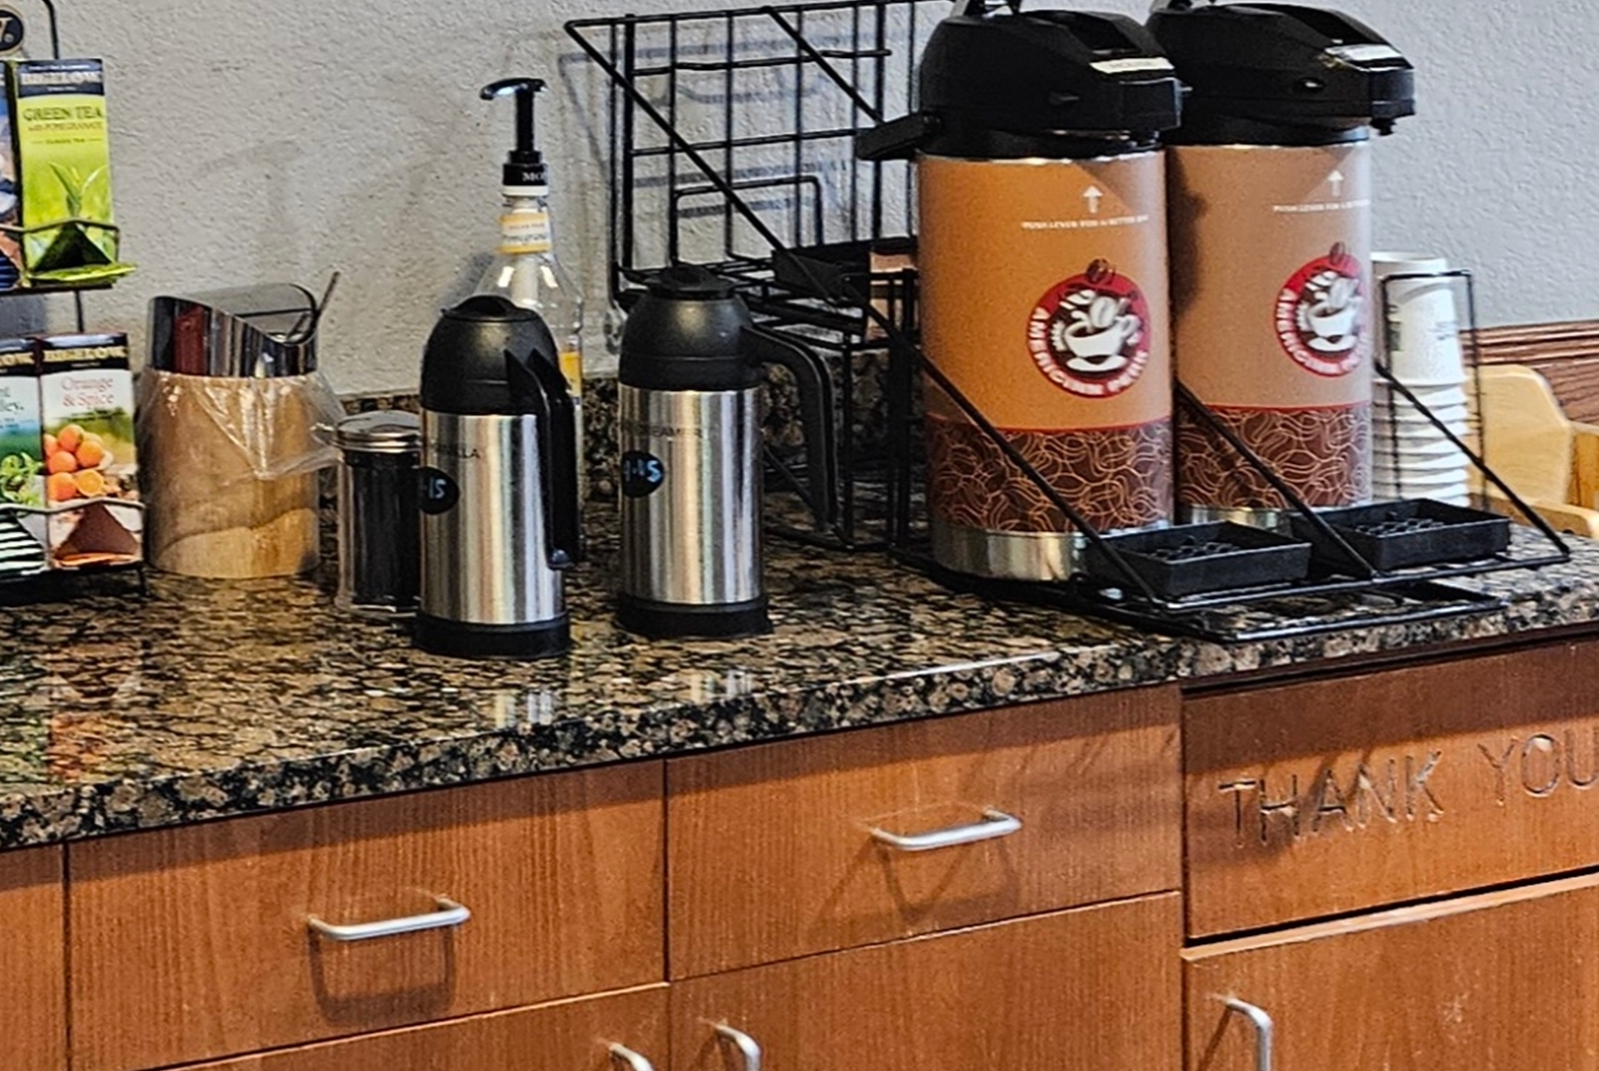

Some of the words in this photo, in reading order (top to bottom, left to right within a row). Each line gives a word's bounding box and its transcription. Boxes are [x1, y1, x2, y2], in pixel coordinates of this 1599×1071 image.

[20, 71, 102, 86] BIGELOW
[23, 107, 71, 121] GREEN
[75, 106, 106, 121] TEA
[42, 345, 129, 364] BIGELOW
[60, 376, 115, 393] Orange
[78, 392, 115, 411] Spice
[1217, 750, 1444, 849] THANK
[1477, 727, 1599, 806] YOU
